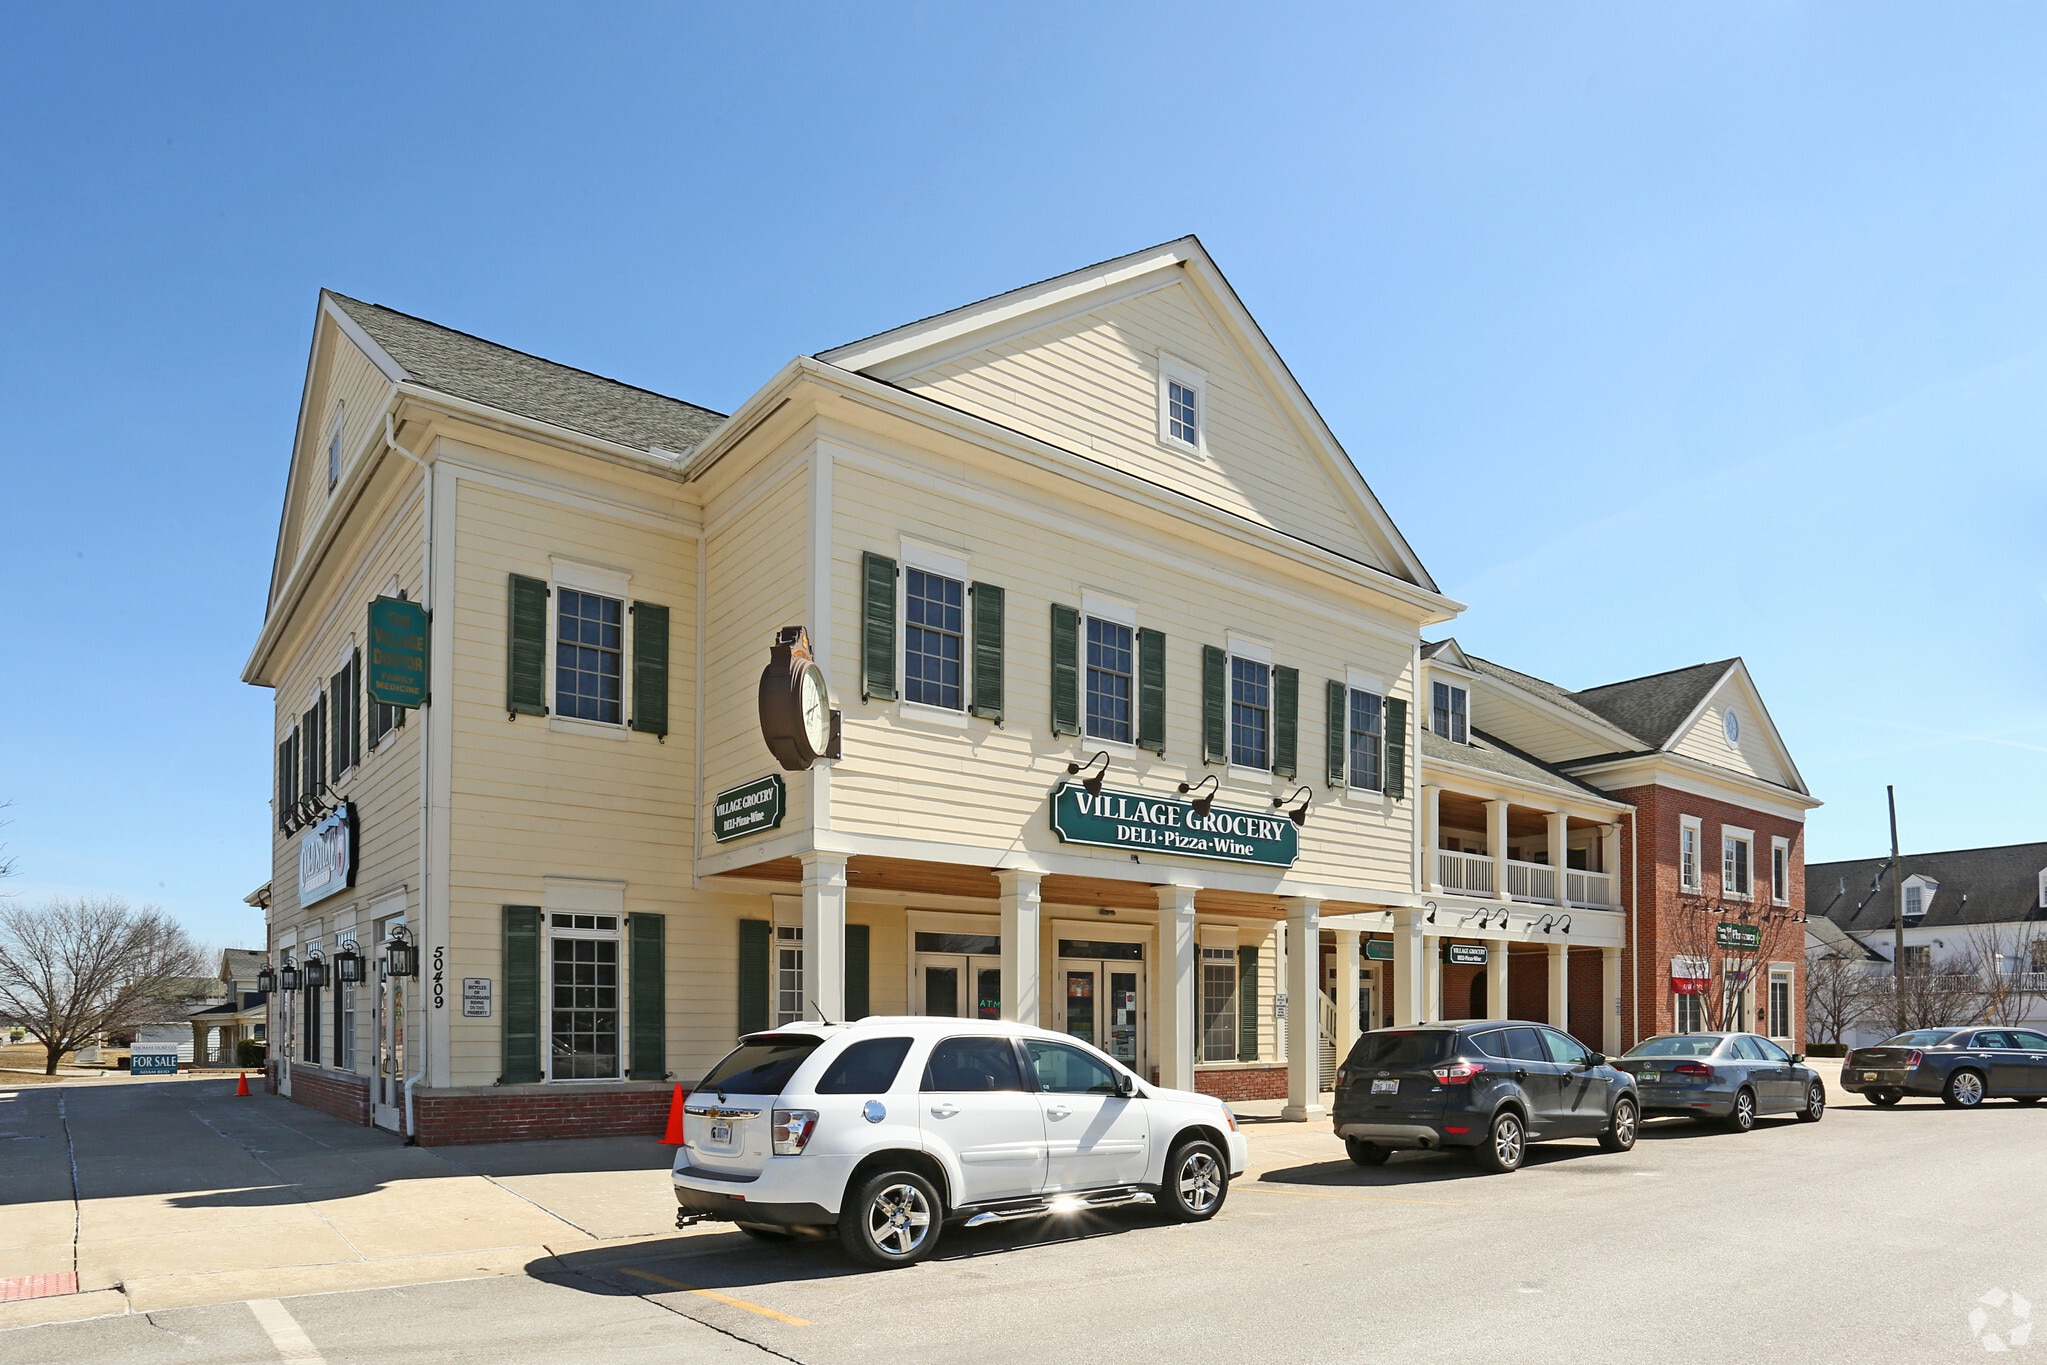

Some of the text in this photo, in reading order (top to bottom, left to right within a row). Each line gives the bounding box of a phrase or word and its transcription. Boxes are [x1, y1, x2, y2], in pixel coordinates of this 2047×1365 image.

[374, 626, 424, 652] VILLAGE
[373, 647, 423, 672] DOCTOR
[376, 681, 420, 694] MEDICINE
[716, 787, 774, 817] VILLAGE GROCERY
[1074, 791, 1286, 842] VILLAGE GROCERY
[433, 946, 444, 1009] 50409
[980, 1000, 1000, 1008] ATM
[133, 1056, 177, 1068] FOR SALE
